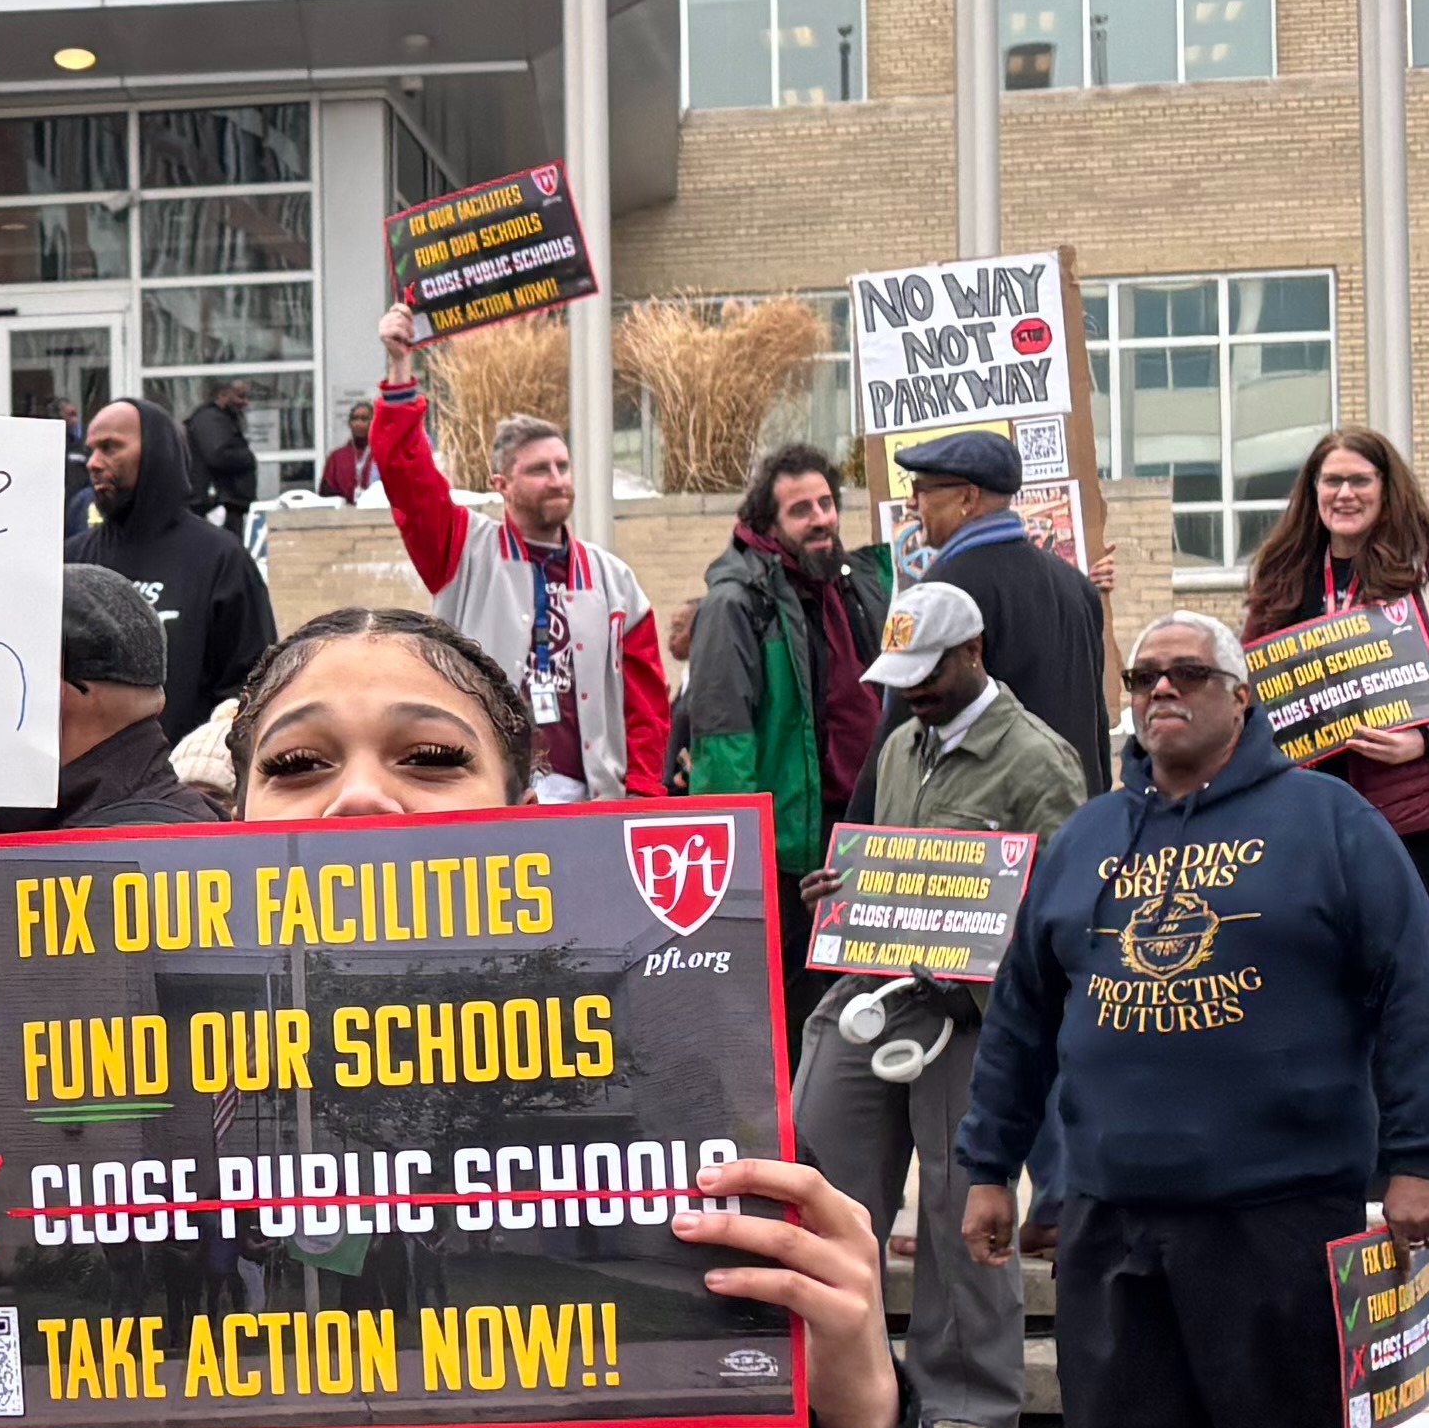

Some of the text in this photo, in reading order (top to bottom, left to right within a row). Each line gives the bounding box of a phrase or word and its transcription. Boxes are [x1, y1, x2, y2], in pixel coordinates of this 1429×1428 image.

[409, 217, 427, 236] FIX
[428, 205, 456, 232] OUR
[457, 184, 524, 219] FACILITIES
[415, 212, 543, 269] FUND OUR SCHOOLS
[421, 236, 577, 300] CLOSE PUBLIC SCHOOLS
[432, 277, 560, 330] TAKE ACTION NOW!!
[858, 264, 1046, 333] NO WAY
[901, 321, 996, 374] NOT
[868, 357, 1052, 429] PARKWAY
[1245, 614, 1371, 672] FIX OUR FACILITIES
[1256, 639, 1393, 702] FUND OUR SCHOOLS
[1267, 661, 1429, 732] CLOSE PUBLIC SCHOOLS
[1280, 699, 1413, 760] TAKE ACTION NOW!!
[864, 835, 886, 858] FIX
[886, 836, 916, 861] OUR
[917, 838, 986, 864] FACILITIES
[15, 851, 555, 958] FIX OUR FACILITIES
[641, 839, 729, 918] pft
[856, 869, 991, 900] FUND OUR SCHOOLS
[1114, 864, 1238, 899] DREAMS
[849, 903, 1008, 935] CLOSE PUBLIC SCHOOLS
[643, 946, 732, 979] pft.org
[843, 940, 971, 970] TAKE ACTION NOW!!
[1087, 966, 1263, 1006] PROTECTING
[1097, 996, 1244, 1033] FUTURES
[21, 993, 616, 1102] FUND OUR SCHOOLS
[30, 1136, 741, 1247] CLOSE PUBLIC SCHOOLS
[1362, 1243, 1382, 1276] FIX
[1368, 1288, 1397, 1324] FUND
[37, 1301, 620, 1403] TAKE ACTION NOW!!
[1371, 1332, 1402, 1371] CLOSE
